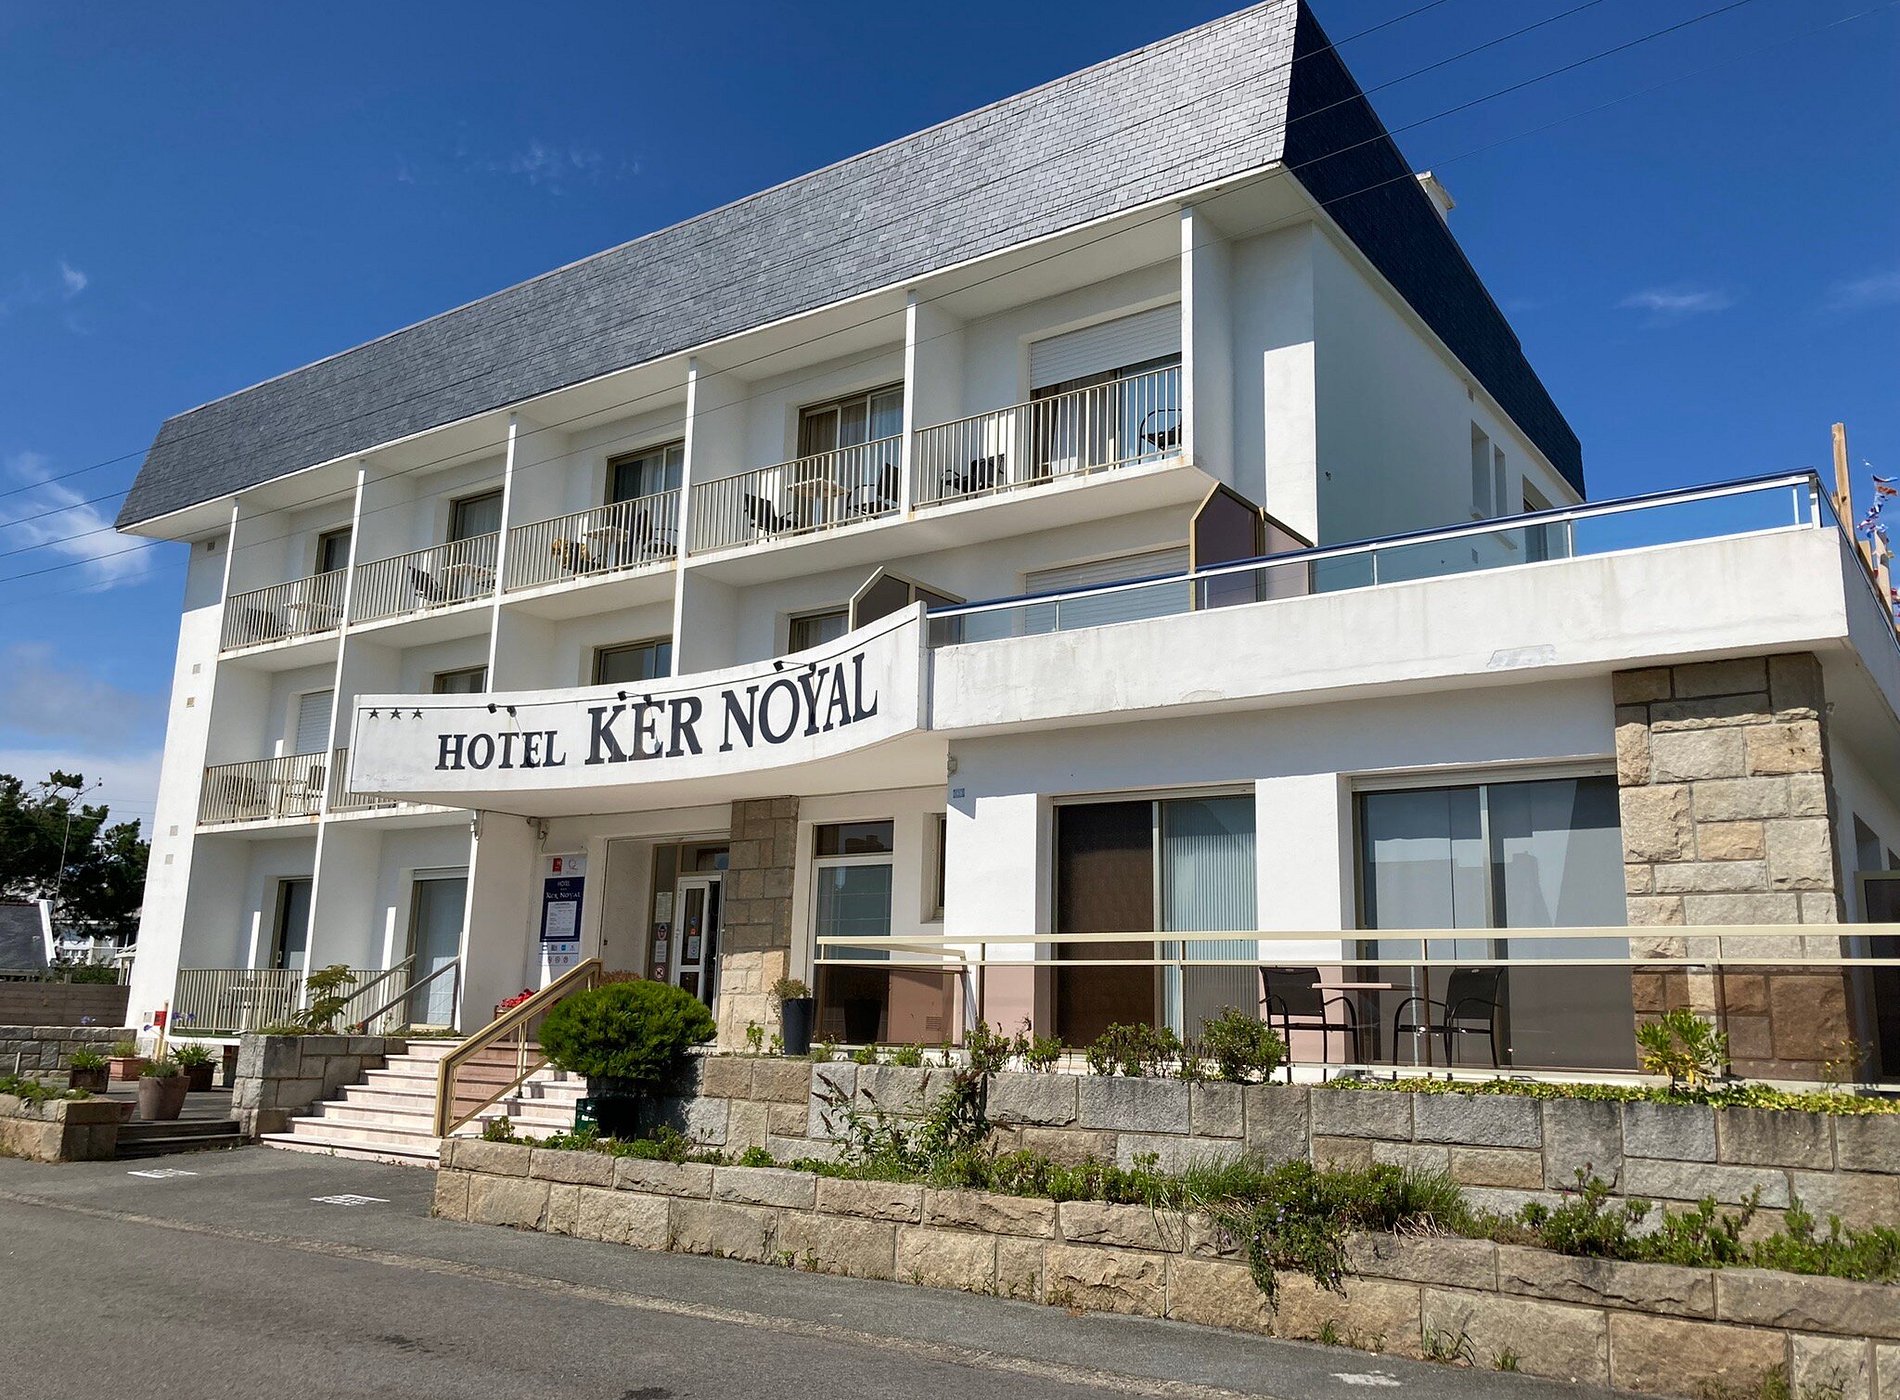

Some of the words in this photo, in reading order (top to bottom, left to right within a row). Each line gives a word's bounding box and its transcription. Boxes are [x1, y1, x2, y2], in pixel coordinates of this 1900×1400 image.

[435, 731, 567, 770] HOTEL
[585, 696, 704, 765] KER
[720, 653, 878, 752] NOYAL
